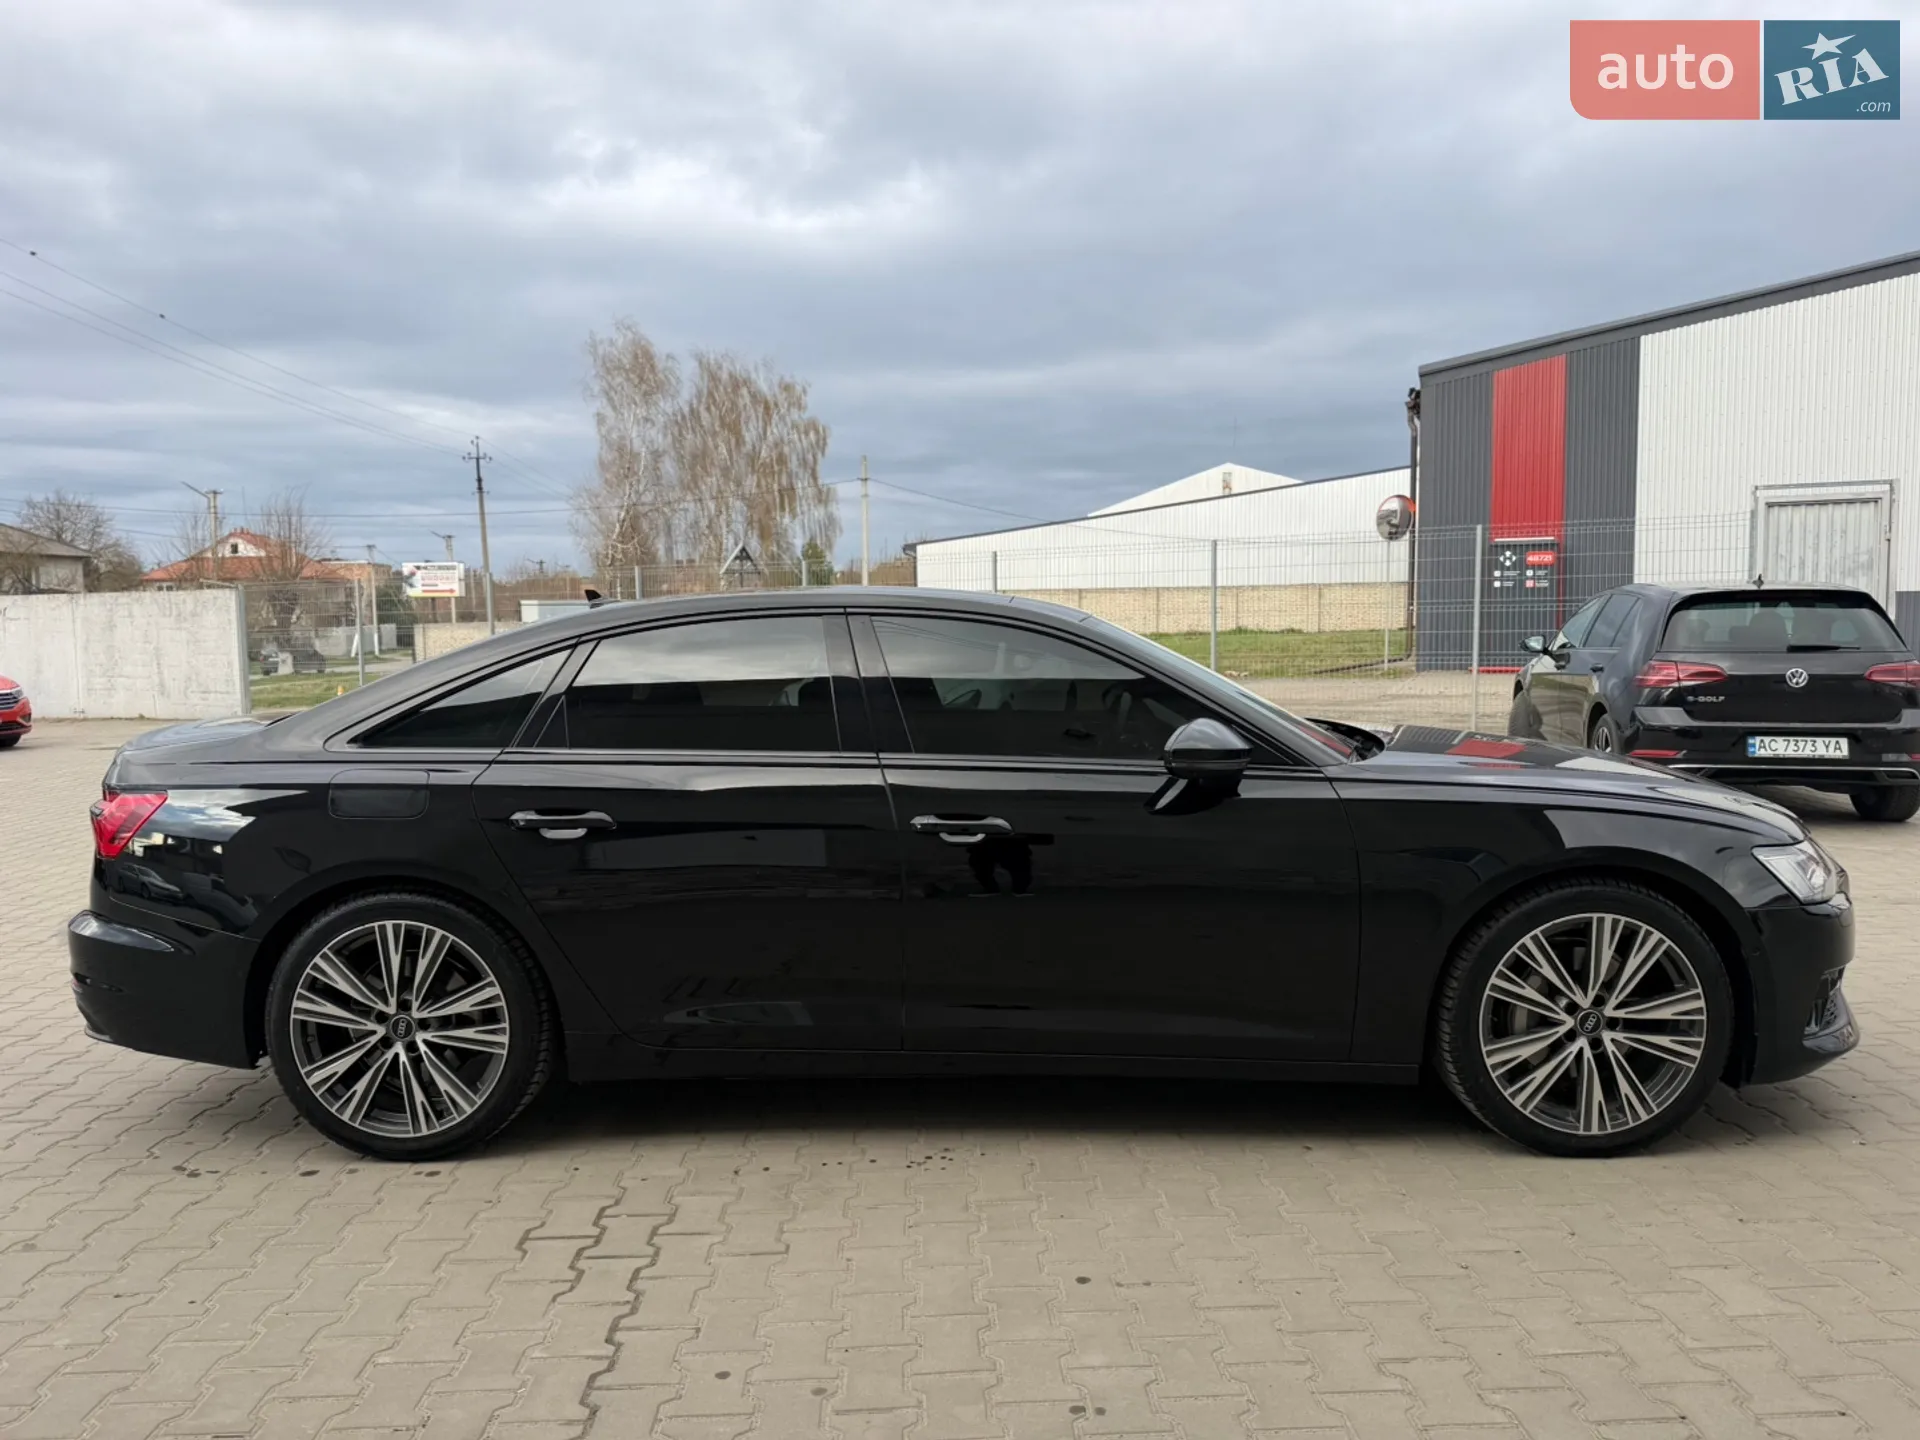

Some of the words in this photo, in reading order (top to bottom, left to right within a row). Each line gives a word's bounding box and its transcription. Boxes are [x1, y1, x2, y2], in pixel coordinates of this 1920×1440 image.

[1757, 738, 1779, 753] AC
[1782, 738, 1818, 753] 7373
[1822, 739, 1843, 754] YA
